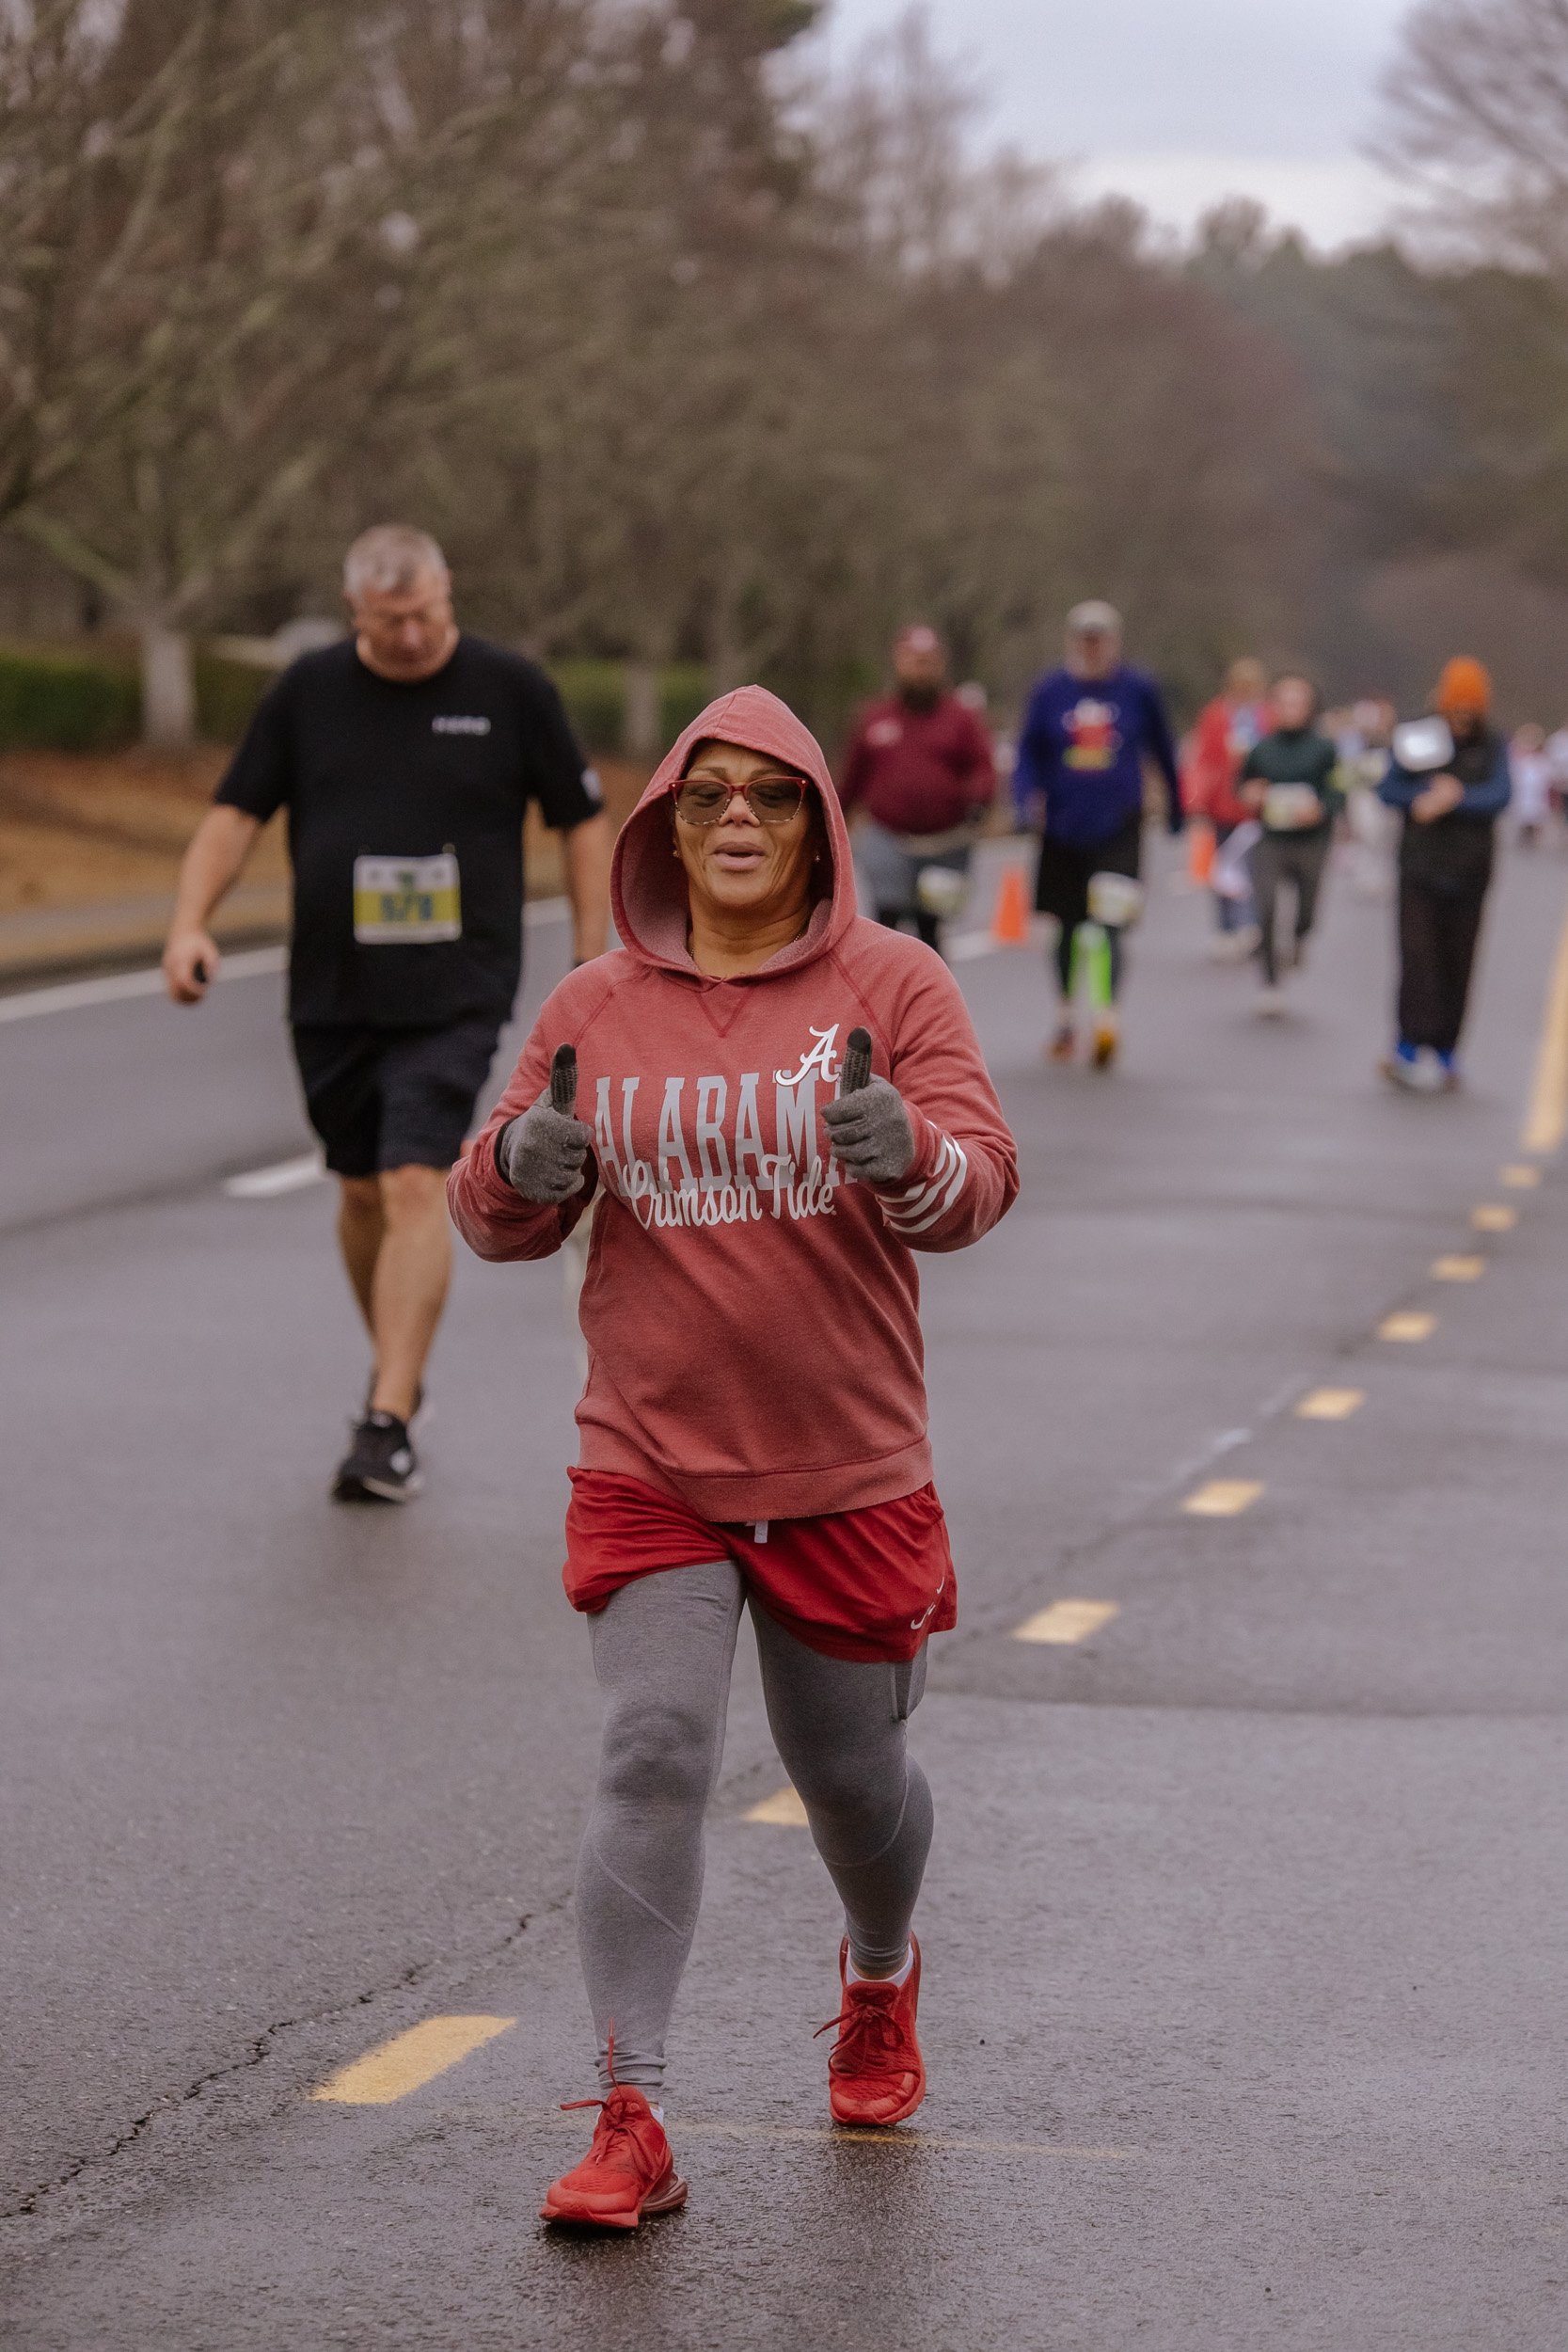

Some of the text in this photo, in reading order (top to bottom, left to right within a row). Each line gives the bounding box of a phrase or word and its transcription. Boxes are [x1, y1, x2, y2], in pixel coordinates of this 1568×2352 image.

[775, 1023, 841, 1086] A
[594, 1064, 858, 1197] ALABAM
[623, 1153, 836, 1231] Crimson Tide
